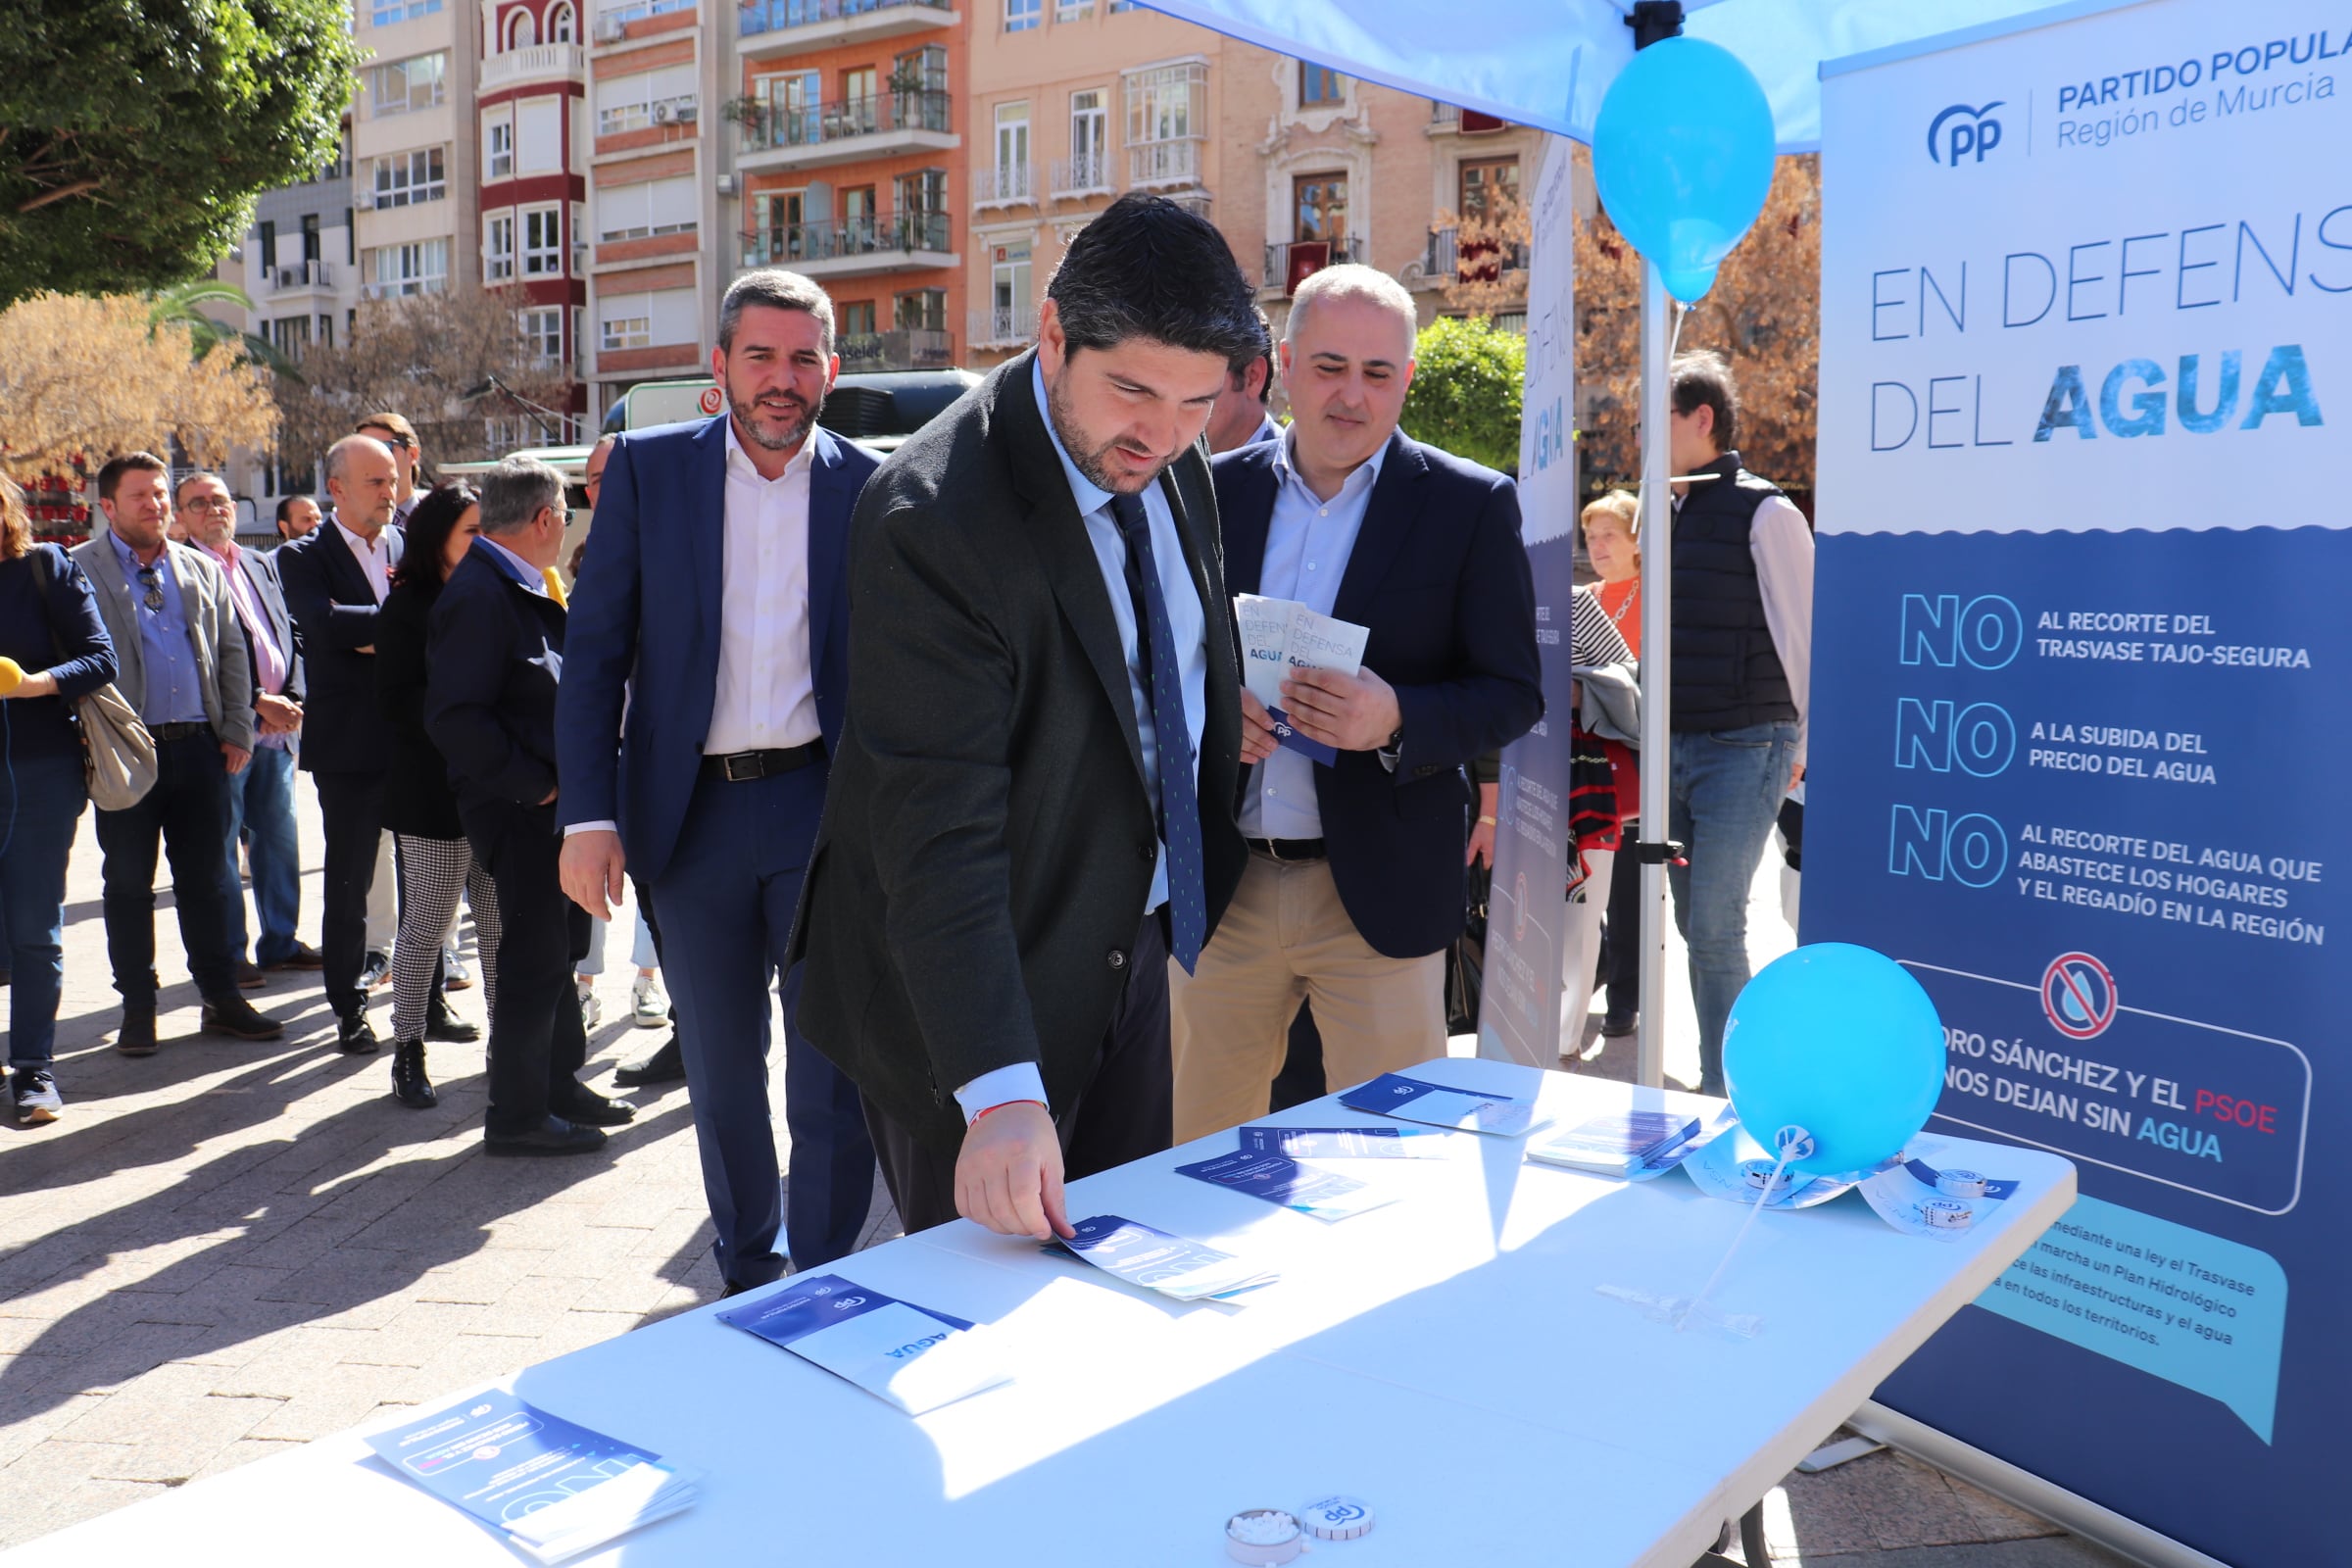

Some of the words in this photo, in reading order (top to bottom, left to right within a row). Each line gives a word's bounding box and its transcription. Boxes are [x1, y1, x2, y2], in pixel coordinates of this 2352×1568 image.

[2058, 60, 2202, 113] PARTIDO
[2058, 109, 2160, 149] Región
[2169, 99, 2207, 128] de
[2217, 72, 2335, 118] Murcia
[1872, 261, 1967, 341] EN
[1871, 374, 2014, 452] DEL
[2032, 343, 2326, 444] AGUA
[1245, 619, 1288, 634] DEFEN
[1899, 593, 2024, 670] NO
[2036, 638, 2144, 662] TRASVASE
[2149, 643, 2312, 669] TAJO-SEGURA
[2037, 611, 2065, 631] AL
[2068, 612, 2169, 634] RECORTE
[2173, 614, 2216, 635] DEL
[1894, 697, 2017, 778] NO
[2029, 749, 2102, 774] PRECIO
[2106, 757, 2149, 778] DEL
[2153, 761, 2218, 785] AGUA
[2030, 721, 2047, 741] A
[2049, 723, 2077, 744] LA
[2080, 725, 2161, 751] SUBIDA
[2164, 732, 2208, 755] DEL
[1888, 804, 2008, 889] NO
[2018, 851, 2125, 884] ABASTECE
[2129, 866, 2173, 891] LOS
[2176, 873, 2288, 909] HOGARES
[2020, 823, 2047, 846] AL
[2050, 827, 2148, 858] RECORTE
[2151, 841, 2194, 865] DEL
[2198, 847, 2264, 875] AGUA
[2268, 857, 2324, 883] QUE
[2017, 877, 2033, 896] Y
[2034, 880, 2059, 901] EL
[2062, 883, 2158, 916] REGADÍO
[2161, 900, 2193, 923] EN
[2196, 905, 2227, 930] LA
[2230, 909, 2326, 946] REGIÓN
[1989, 1038, 2119, 1095] SÁNCHEZ
[2125, 1070, 2146, 1099] Y
[2150, 1078, 2186, 1111] EL
[2194, 1088, 2278, 1135] PSOE
[1993, 1077, 2079, 1125] DEJAN
[2082, 1101, 2131, 1138] SIN
[2135, 1116, 2224, 1163] AGUA
[2030, 1260, 2049, 1278] las
[2050, 1269, 2164, 1320] infraestructuras
[2164, 1312, 2176, 1326] y
[2178, 1315, 2193, 1331] el
[2194, 1323, 2234, 1347] agua
[2038, 1242, 2090, 1268] marcha
[2092, 1258, 2112, 1275] un
[2113, 1264, 2146, 1288] Plan
[2147, 1277, 2237, 1319] Hidrológico
[2115, 1241, 2143, 1259] una
[2144, 1249, 2167, 1269] ley
[2169, 1258, 2184, 1273] el
[2187, 1261, 2256, 1297] Trasvase
[2004, 1280, 2021, 1294] en
[2022, 1285, 2061, 1309] todos
[2061, 1298, 2083, 1317] los
[2084, 1308, 2161, 1347] territorios.
